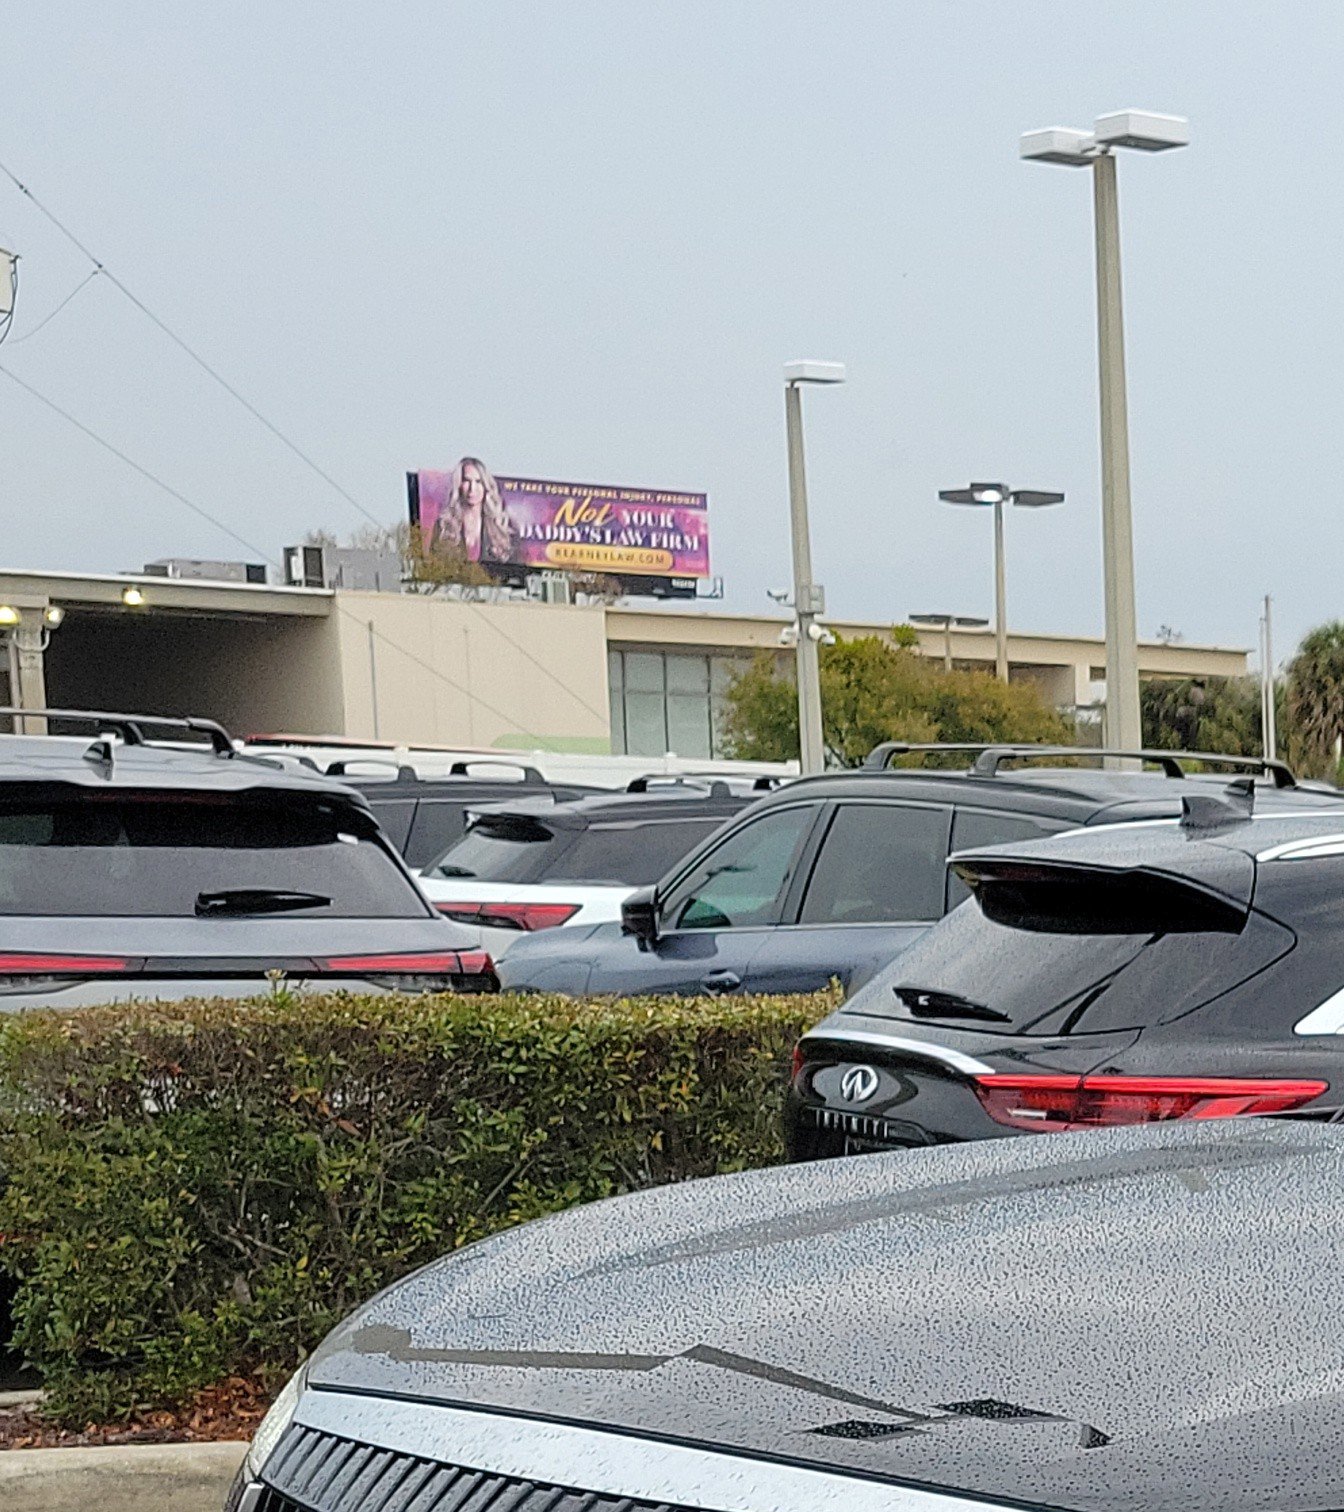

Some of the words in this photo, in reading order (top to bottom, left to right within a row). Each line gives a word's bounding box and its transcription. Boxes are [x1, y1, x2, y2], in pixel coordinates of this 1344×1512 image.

[553, 495, 613, 527] Not
[622, 508, 675, 529] YOUR
[519, 523, 602, 544] DADDY'S
[604, 528, 646, 547] LAW
[650, 531, 699, 552] FIRM
